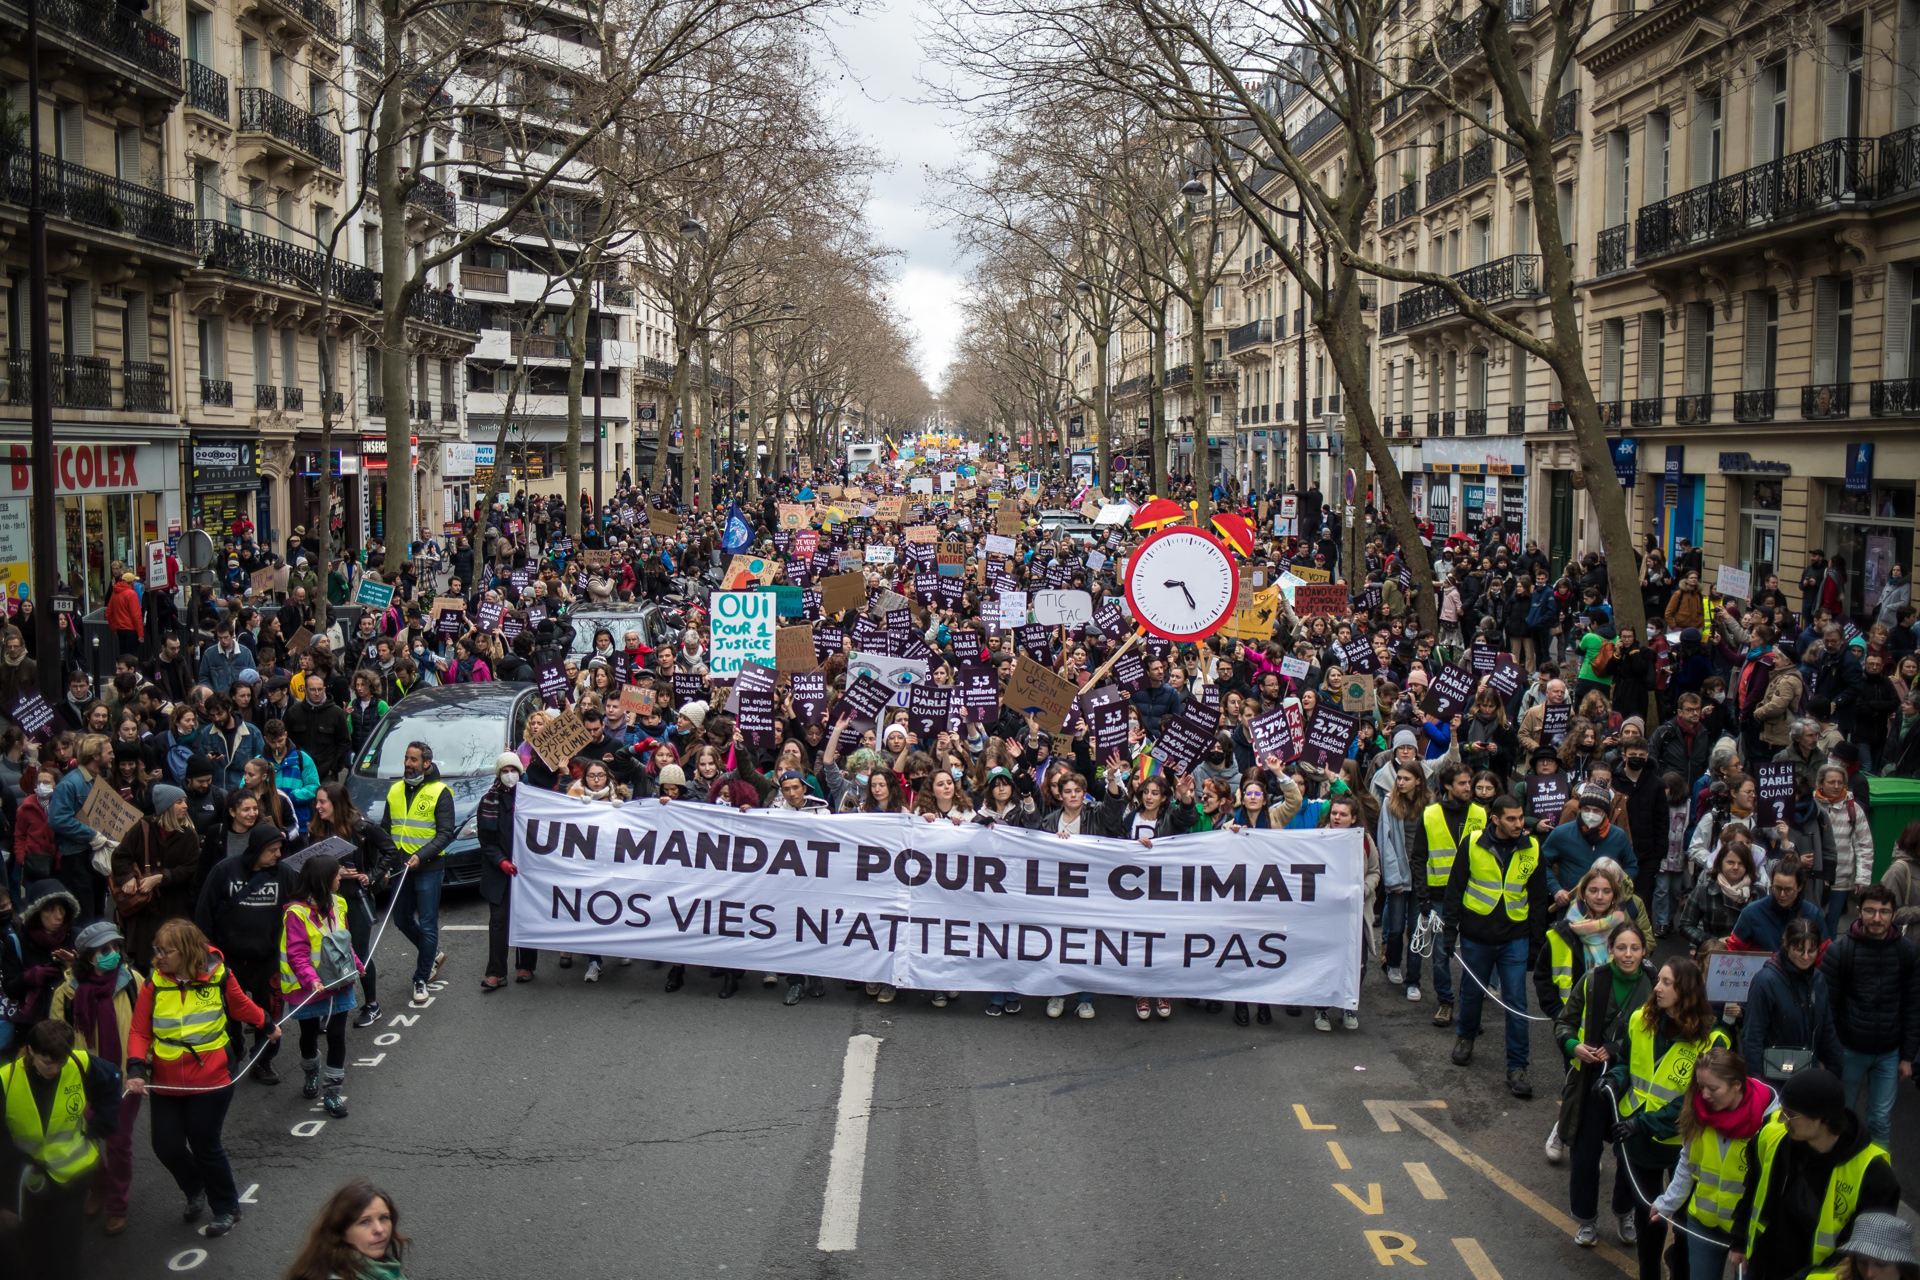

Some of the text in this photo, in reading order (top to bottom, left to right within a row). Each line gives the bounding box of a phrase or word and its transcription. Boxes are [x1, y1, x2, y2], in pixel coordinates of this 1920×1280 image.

[363, 440, 388, 453] ENSEIG
[477, 447, 493, 455] AUTO
[10, 444, 138, 490] BICOLEX
[475, 456, 495, 464] ECOLE
[1666, 461, 1678, 470] BRED
[1718, 452, 1749, 470] BRED
[1435, 464, 1450, 472] PRESSING
[946, 544, 964, 555] QUE
[938, 555, 964, 564] NOTRE
[1308, 573, 1329, 583] VOTE
[942, 583, 963, 592] PARLE
[1296, 587, 1326, 597] QUAND
[1040, 593, 1067, 609] TIC
[480, 607, 501, 617] PARLE
[1057, 608, 1082, 622] TAC
[1321, 605, 1346, 614] FOUTU
[1097, 610, 1118, 624] PARLE
[1101, 614, 1121, 629] QUAND
[712, 619, 773, 637] POUR 1
[1027, 632, 1046, 640] PARLE
[954, 641, 977, 649] PARLE
[1347, 642, 1370, 656] PARLE
[1350, 649, 1373, 662] QUAND
[542, 668, 558, 680] 3,3
[1022, 660, 1050, 681] LIKE
[1444, 666, 1474, 686] ON EN
[1502, 665, 1519, 679] 3,3
[540, 677, 566, 689] milliards
[793, 675, 807, 683] ON
[972, 675, 990, 687] 3,3
[1439, 673, 1470, 694] PARLE
[1493, 671, 1518, 689] milliards
[623, 685, 655, 699] PLANETE
[793, 683, 824, 691] PARLE
[914, 688, 948, 699] ON EN
[965, 687, 997, 696] milliards
[1026, 675, 1058, 698] OCEAN
[1434, 682, 1465, 702] QUAND
[793, 692, 824, 700] QUAND
[913, 696, 948, 707] PARLE
[1015, 680, 1068, 717] WE RISE
[620, 699, 652, 712] DANGER
[803, 702, 815, 717] ?
[911, 706, 946, 716] QUAND
[1437, 698, 1450, 713] ?
[1104, 709, 1122, 724] 3,3
[1251, 710, 1283, 728] Seulement
[1318, 710, 1354, 728] Seulement
[1545, 713, 1569, 723] 2,7%
[532, 711, 574, 748] CHANGEZ LE
[920, 718, 934, 733] ?
[1098, 722, 1127, 736] milliards
[1171, 720, 1205, 744] Un enjeu
[1254, 717, 1287, 740] 2,7%
[1313, 718, 1350, 740] 2,7%
[540, 721, 582, 758] SYSTEME PAS
[1167, 728, 1202, 749] capital pour
[1258, 729, 1289, 748] du débat
[1260, 736, 1291, 754] médiatique
[1310, 731, 1347, 749] du débat
[550, 730, 590, 766] LE CLIMAT
[1162, 734, 1196, 758] 94% des
[1308, 738, 1344, 755] médiatique
[1759, 766, 1793, 776] ON EN
[1537, 781, 1557, 794] 3,3
[1760, 776, 1793, 787] PARLE
[1532, 793, 1566, 803] milliards
[1760, 787, 1794, 799] QUAND
[1772, 801, 1785, 819] ?
[526, 819, 1326, 902] UN MANDAT POUR LE CLIMAT
[233, 884, 276, 896] VKA
[552, 886, 1287, 968] NOS VIES N'ATTENDENT PAS
[1719, 955, 1744, 971] SOS
[1715, 969, 1746, 977] ANIMAUX
[1678, 1047, 1697, 1059] ACTIO
[1667, 1074, 1688, 1087] COP2
